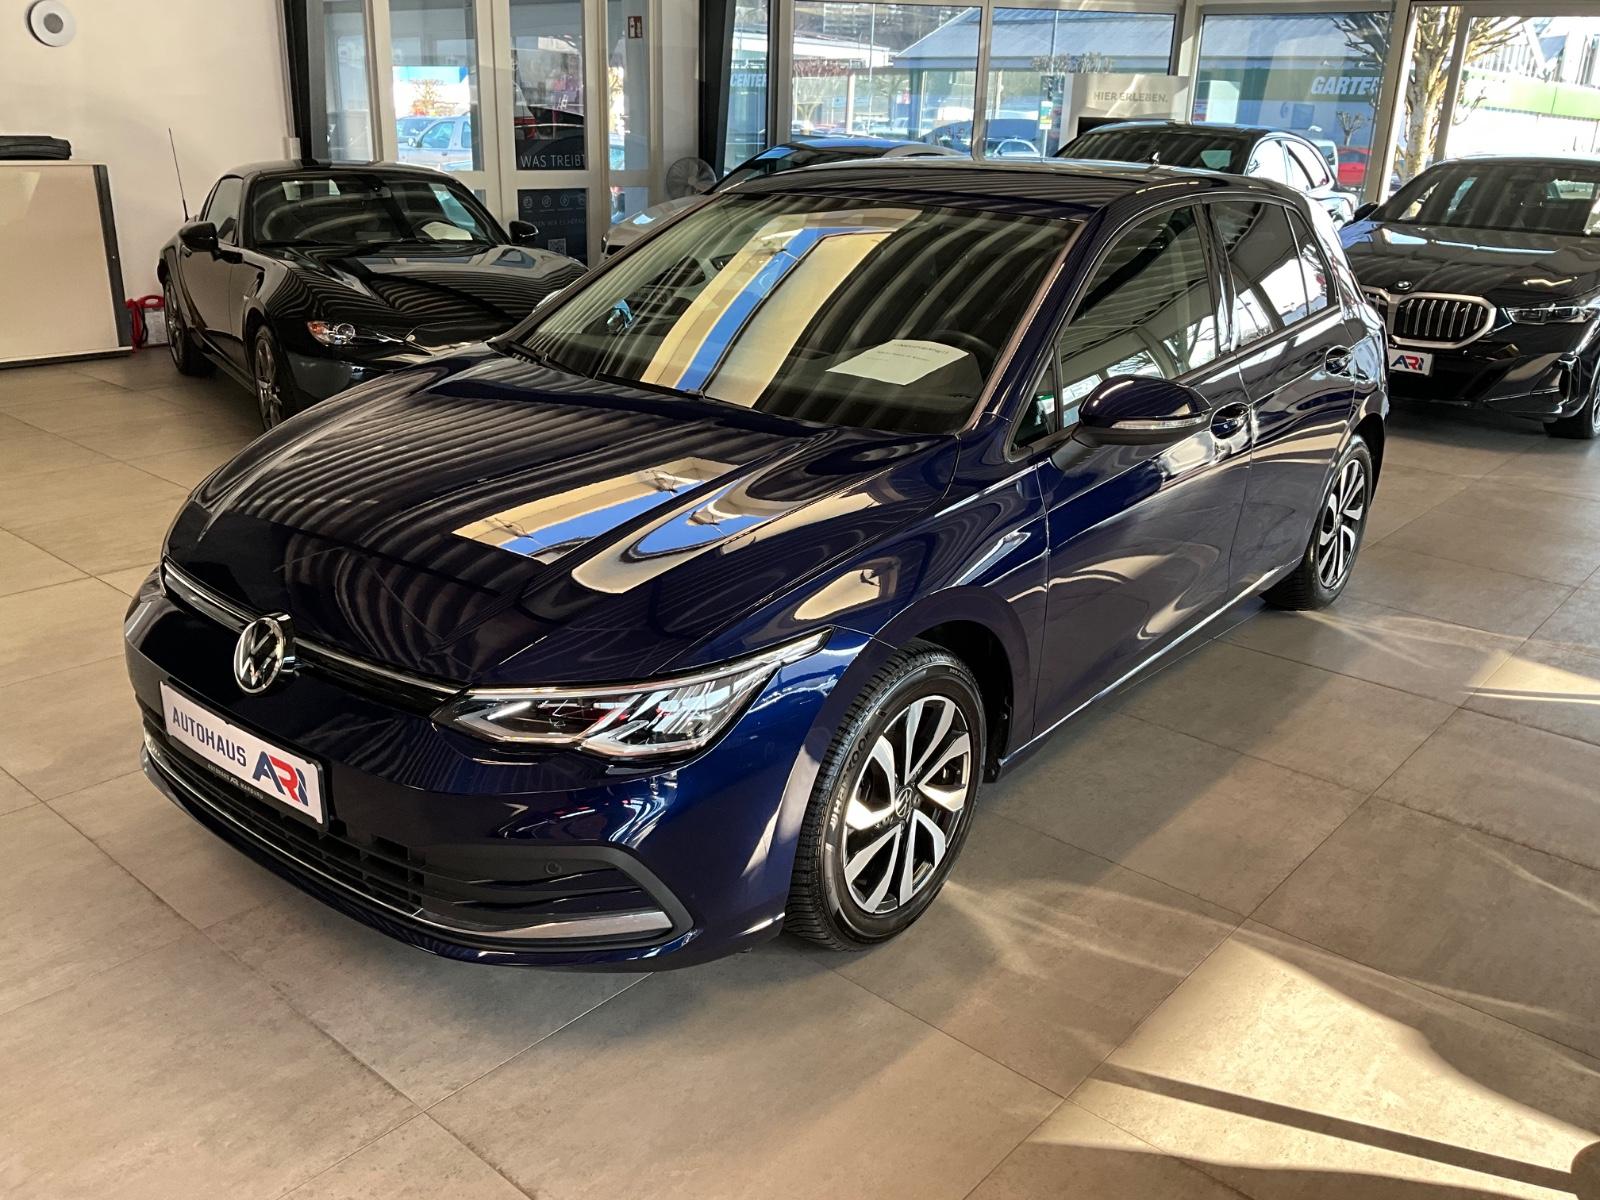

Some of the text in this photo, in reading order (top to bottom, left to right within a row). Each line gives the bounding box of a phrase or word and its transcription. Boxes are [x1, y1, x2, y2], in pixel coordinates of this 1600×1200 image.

[1094, 91, 1117, 101] HIER
[520, 155, 546, 168] WAS
[172, 706, 309, 807] AUTOHAUS ARI
